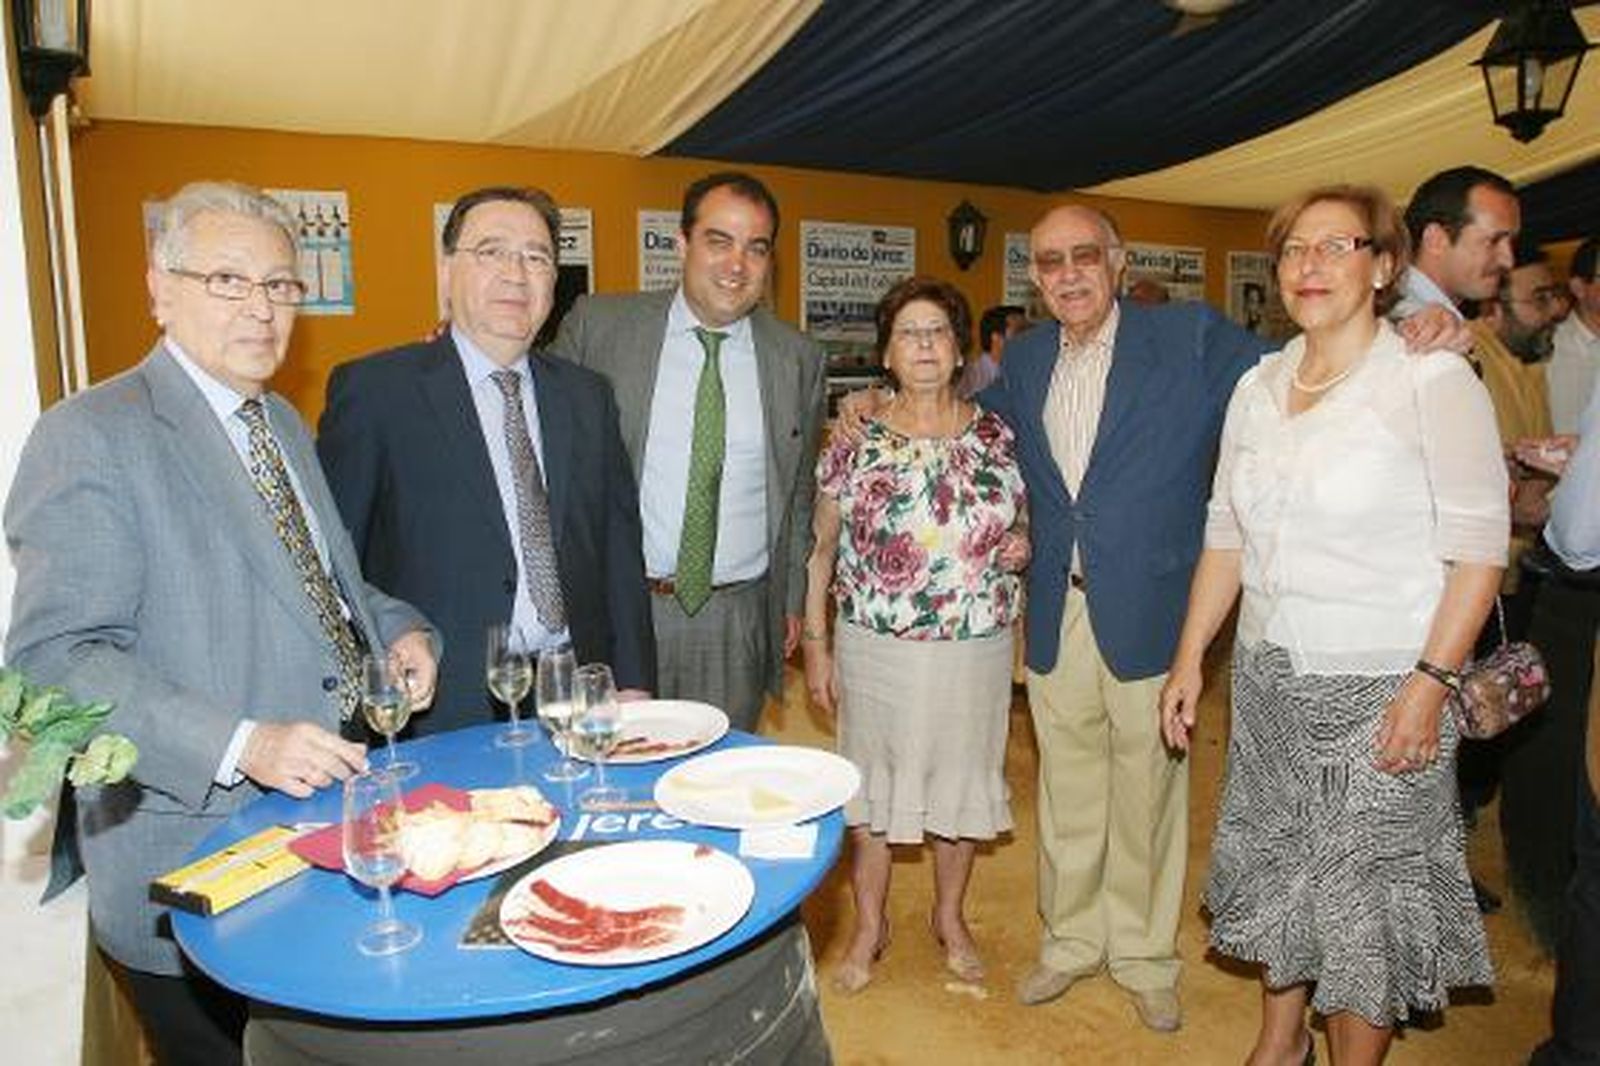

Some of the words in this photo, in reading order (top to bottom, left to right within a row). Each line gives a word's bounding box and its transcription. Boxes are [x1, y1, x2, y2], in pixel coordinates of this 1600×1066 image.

[645, 231, 675, 250] Dia
[806, 242, 849, 259] Diario
[569, 812, 686, 841] jere
